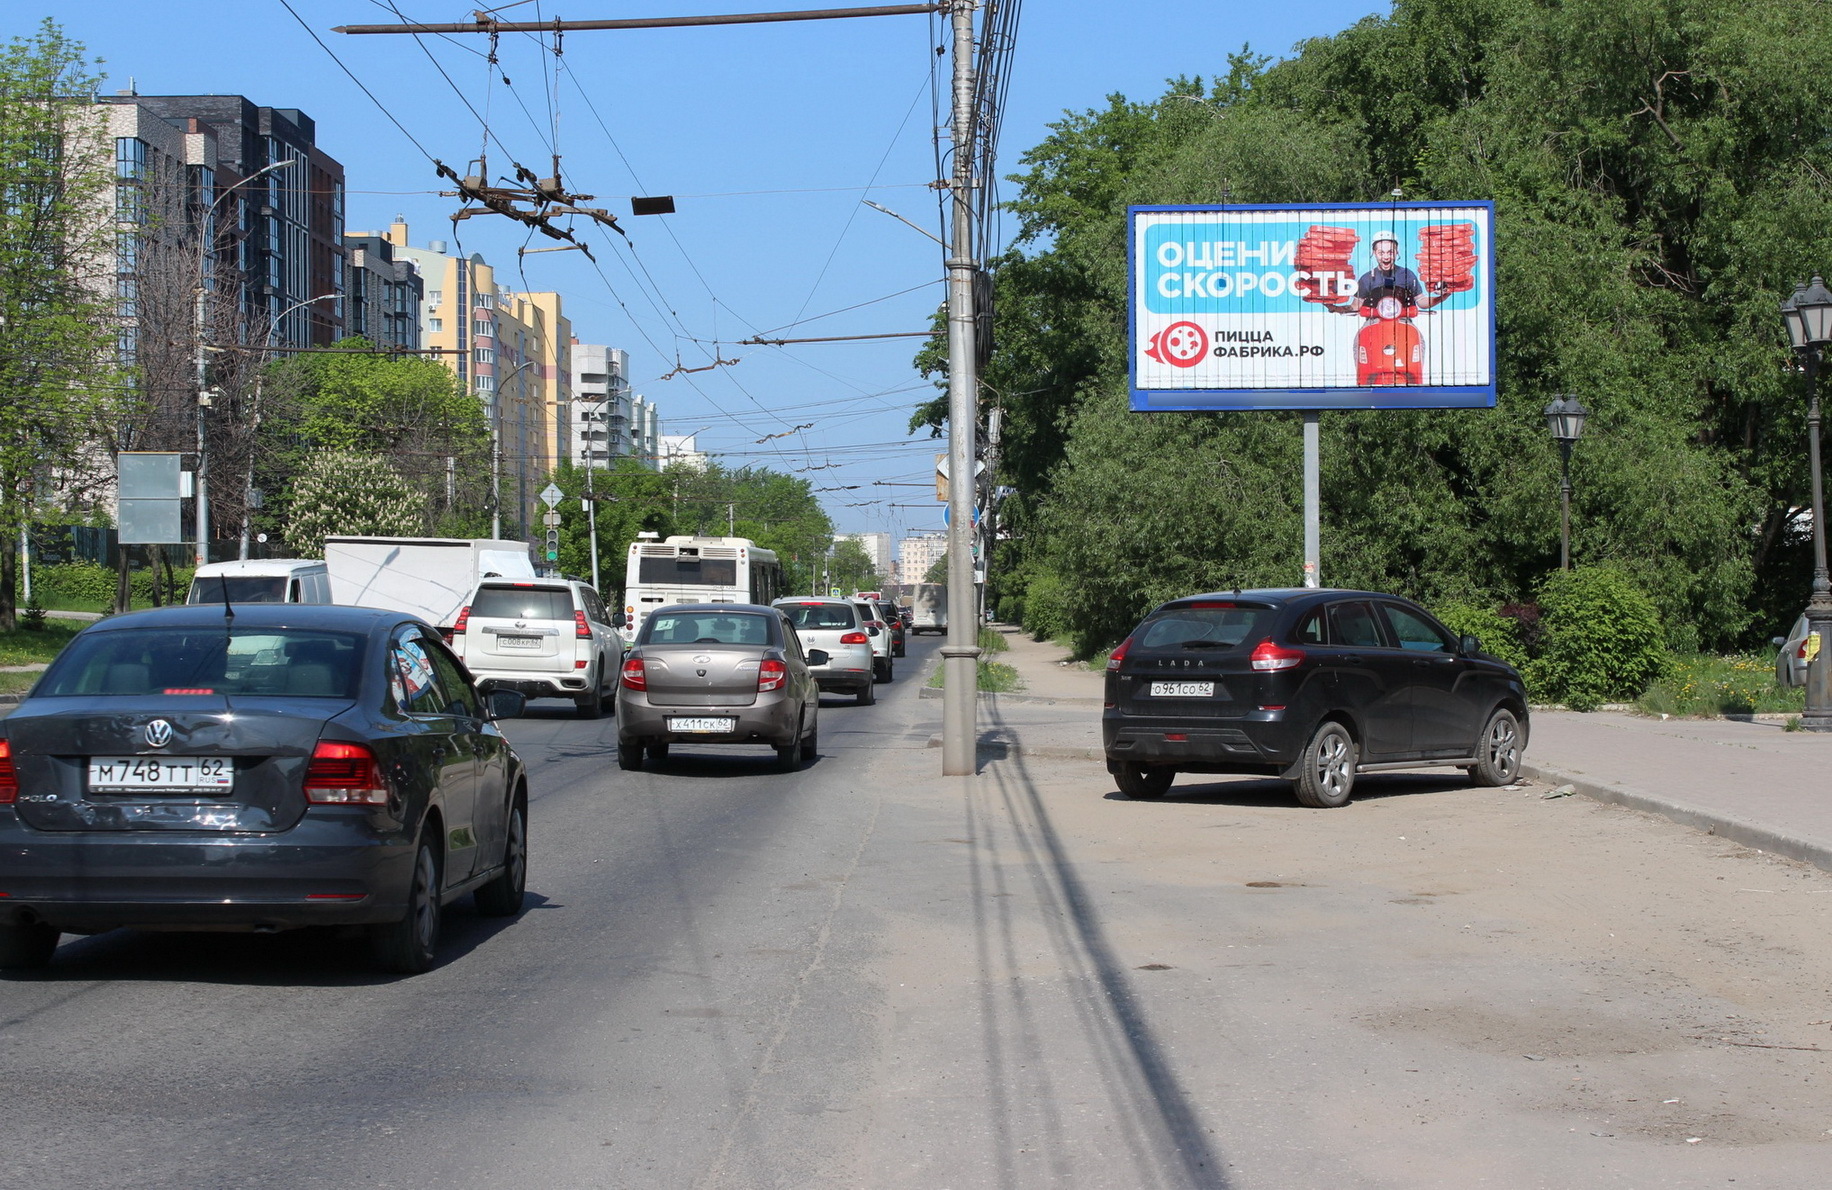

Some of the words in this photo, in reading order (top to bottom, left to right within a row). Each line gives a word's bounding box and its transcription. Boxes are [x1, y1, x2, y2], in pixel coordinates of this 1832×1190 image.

[1156, 241, 1295, 270] ОЦЕНИ
[1156, 271, 1359, 298] СКОРОСТЬ
[1214, 331, 1273, 344] ПИЦЦА
[1213, 345, 1325, 358] ФАБРИКА.РФ
[201, 759, 223, 776] 62
